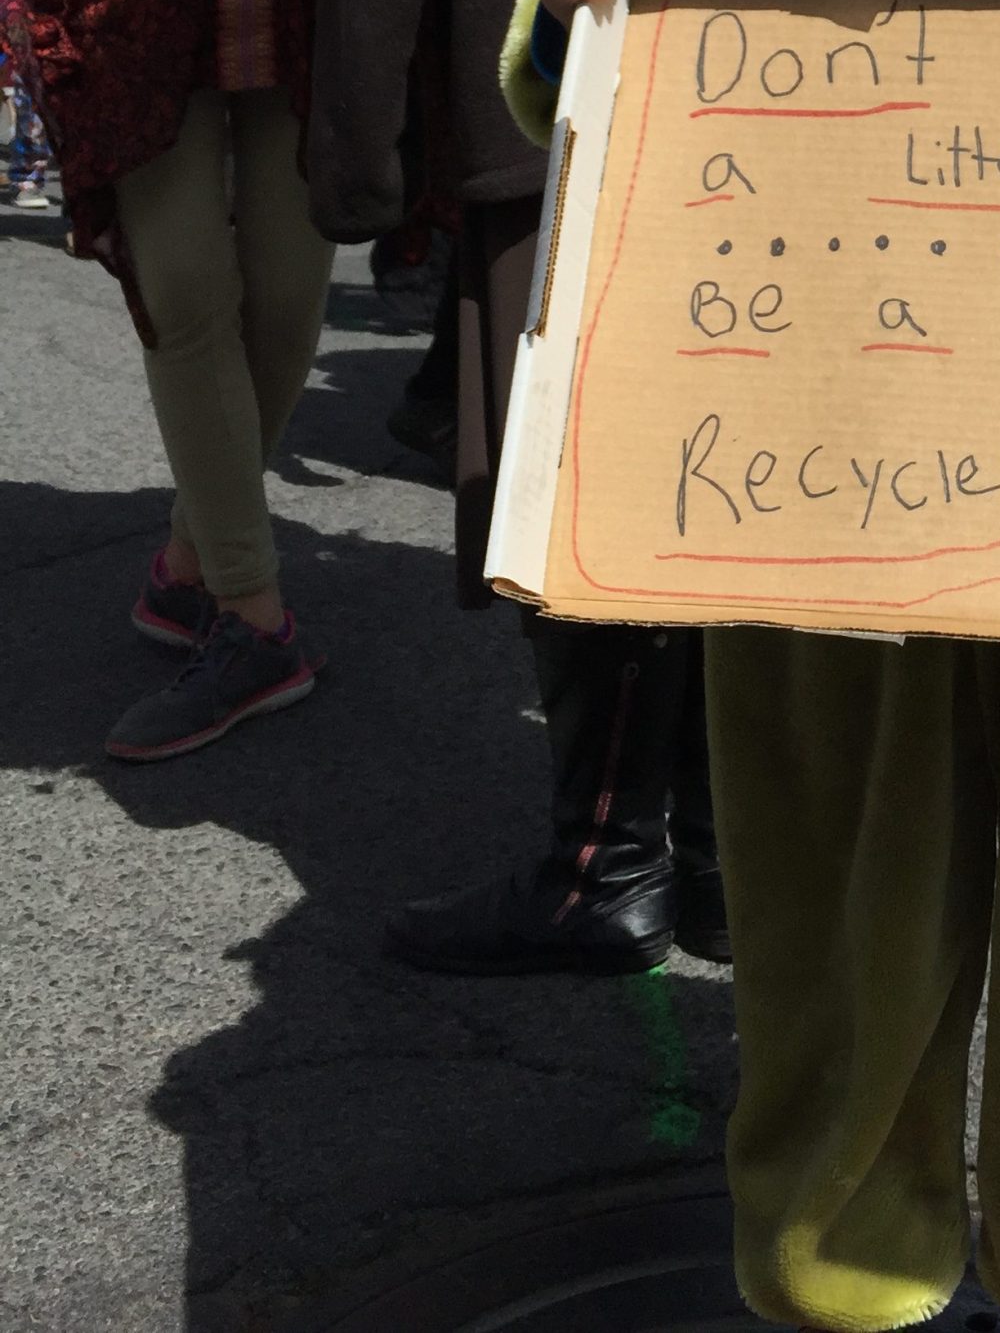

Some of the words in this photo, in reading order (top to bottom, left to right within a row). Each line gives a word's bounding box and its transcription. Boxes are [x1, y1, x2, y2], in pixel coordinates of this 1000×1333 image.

[698, 0, 935, 103] Don't
[702, 152, 756, 194] a
[690, 281, 792, 338] Be
[878, 297, 927, 336] a
